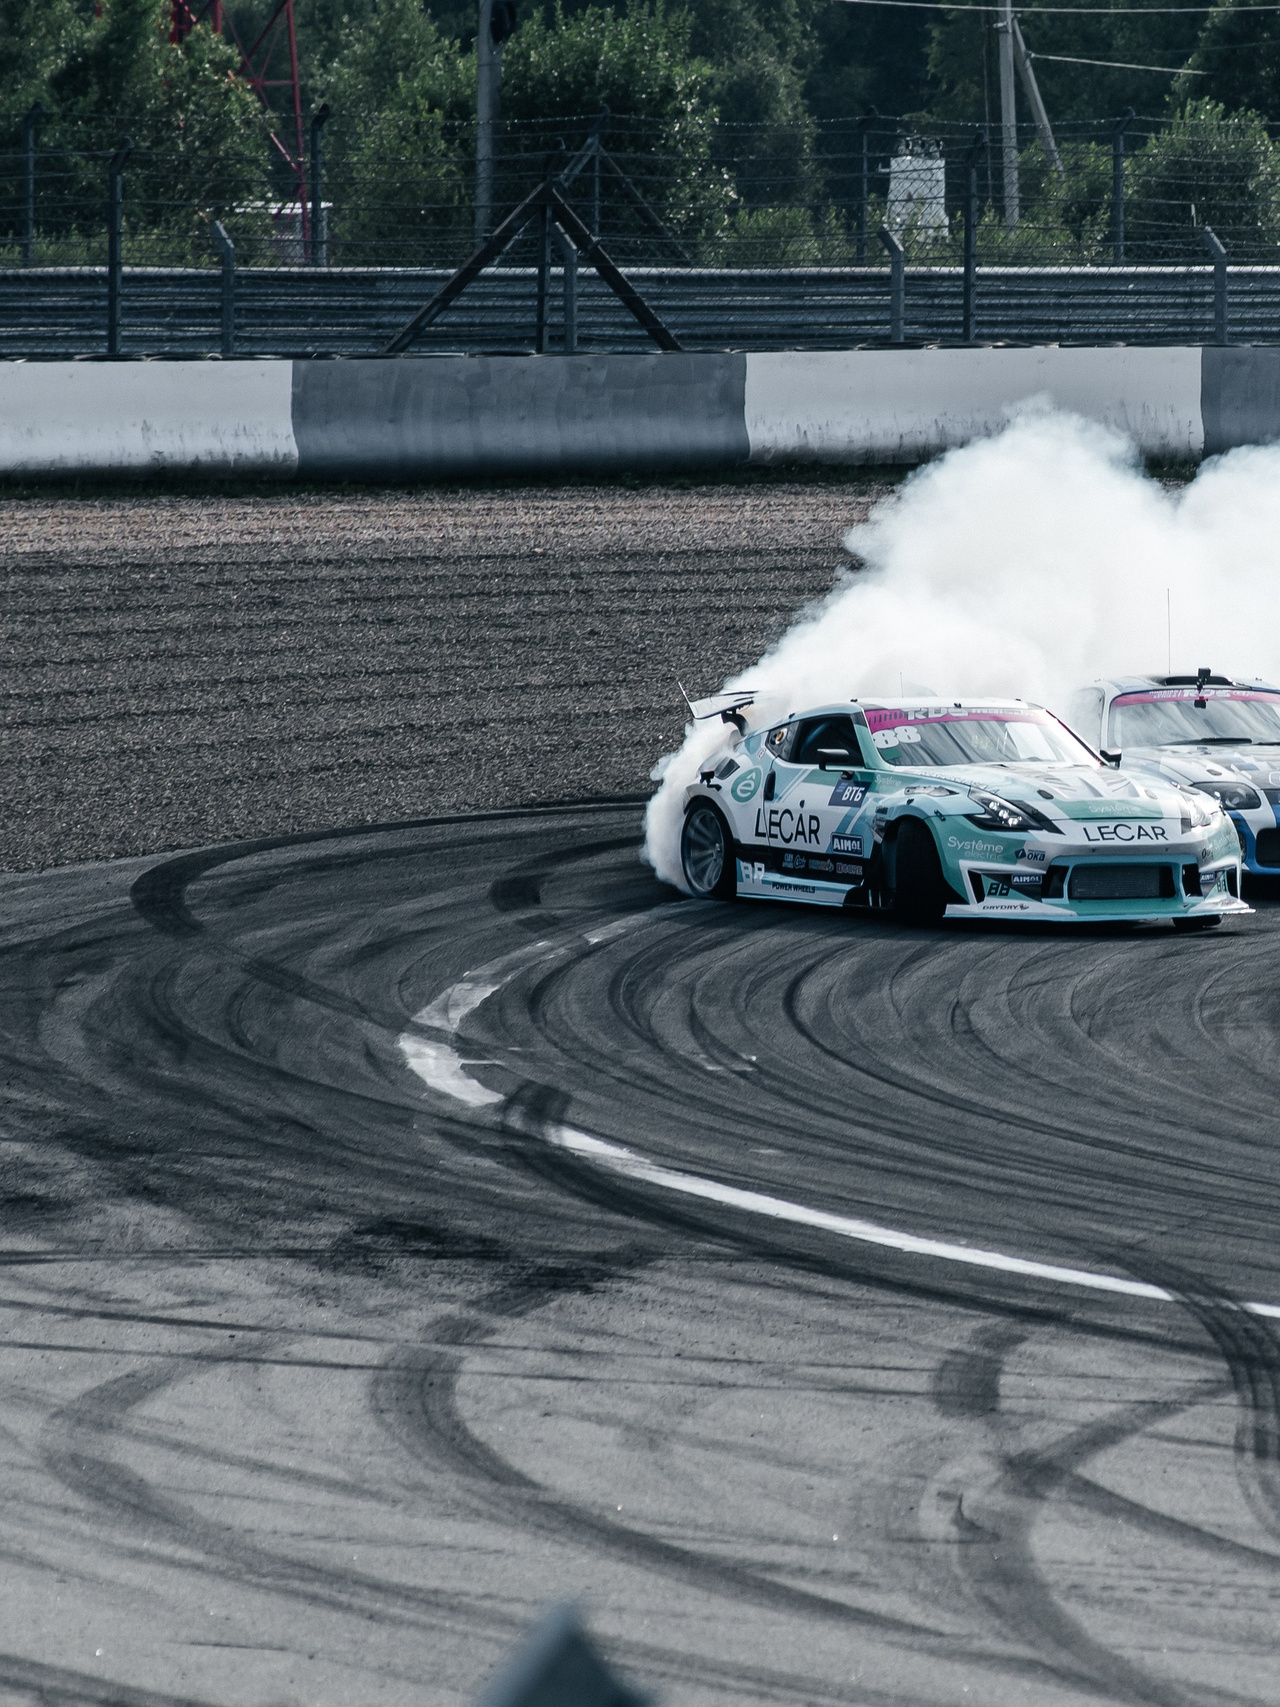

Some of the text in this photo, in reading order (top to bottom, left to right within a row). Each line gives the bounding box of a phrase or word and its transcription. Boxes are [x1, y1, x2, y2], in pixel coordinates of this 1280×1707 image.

[872, 726, 921, 748] 88
[841, 786, 866, 802] ВТБ
[754, 808, 821, 845] LECAR
[1083, 823, 1169, 842] LECAR
[947, 836, 1004, 854] Systême
[772, 883, 816, 893] POWER WHEELS
